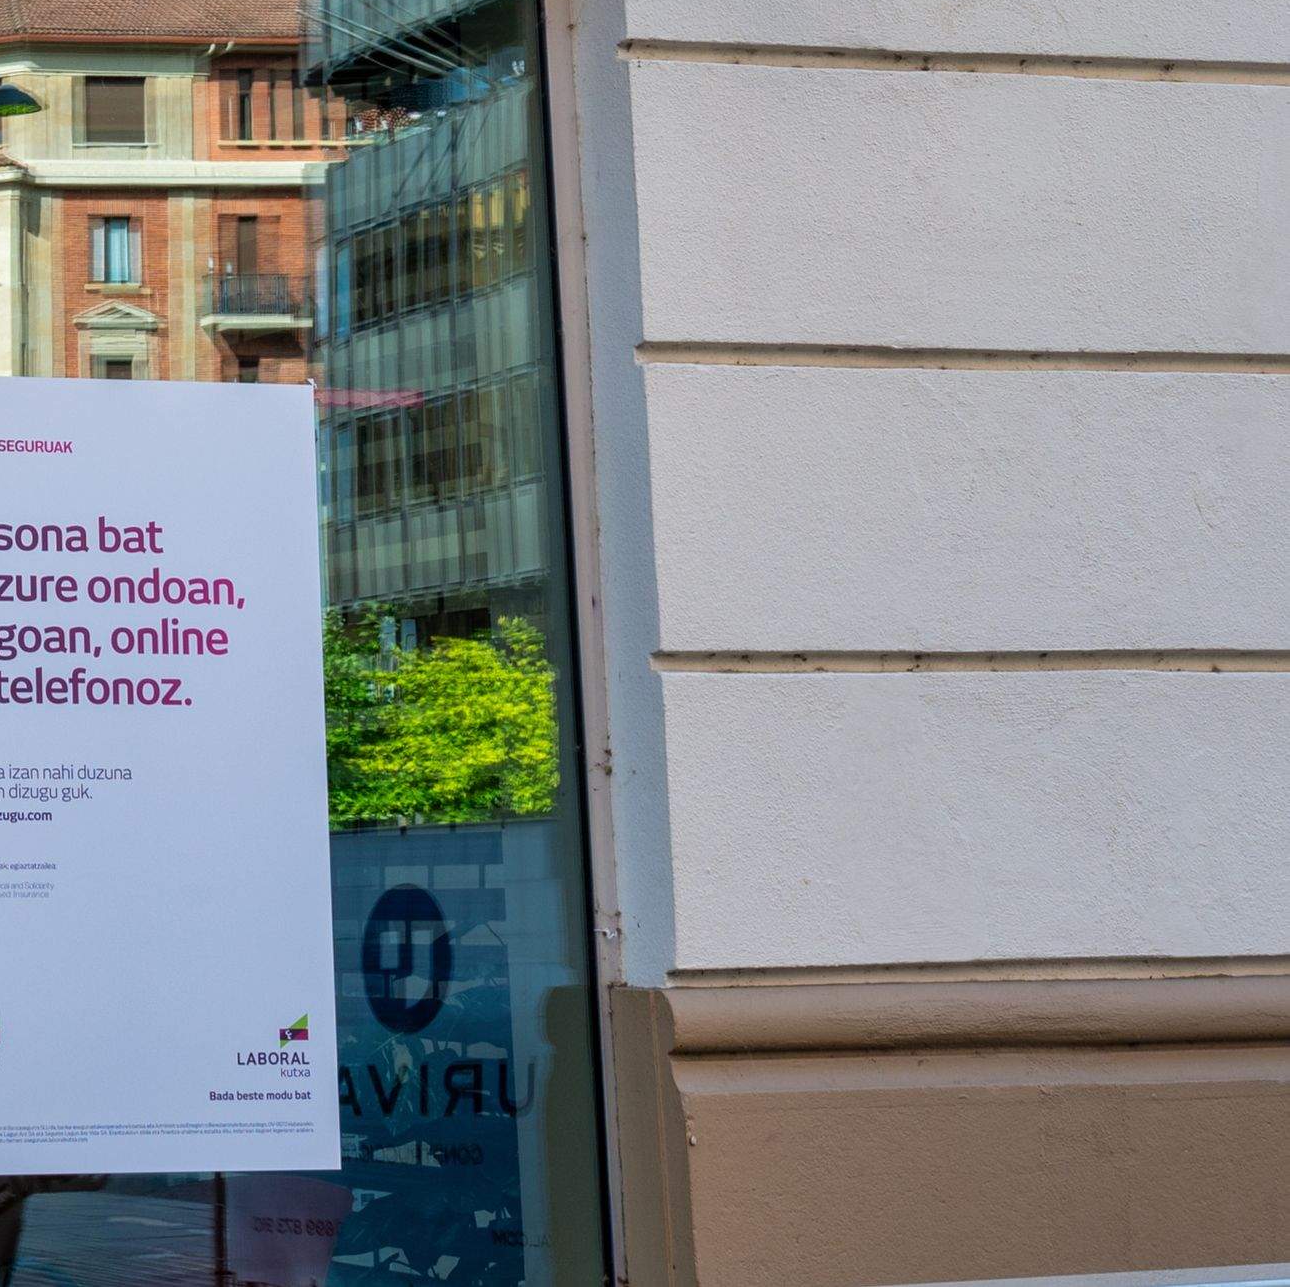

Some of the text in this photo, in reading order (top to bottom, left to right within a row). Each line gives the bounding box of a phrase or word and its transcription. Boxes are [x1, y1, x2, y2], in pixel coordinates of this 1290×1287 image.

[99, 516, 163, 553] bat
[88, 568, 244, 609] ondoan,
[111, 618, 228, 655] online
[9, 764, 39, 779] izan
[43, 765, 73, 779] nahi
[78, 765, 132, 780] duzuna
[9, 784, 57, 802] dizugu
[62, 784, 92, 802] guk.
[238, 1052, 309, 1065] LABORAL
[281, 1068, 310, 1077] kutxa
[210, 1091, 311, 1100] Bada beste modu bat
